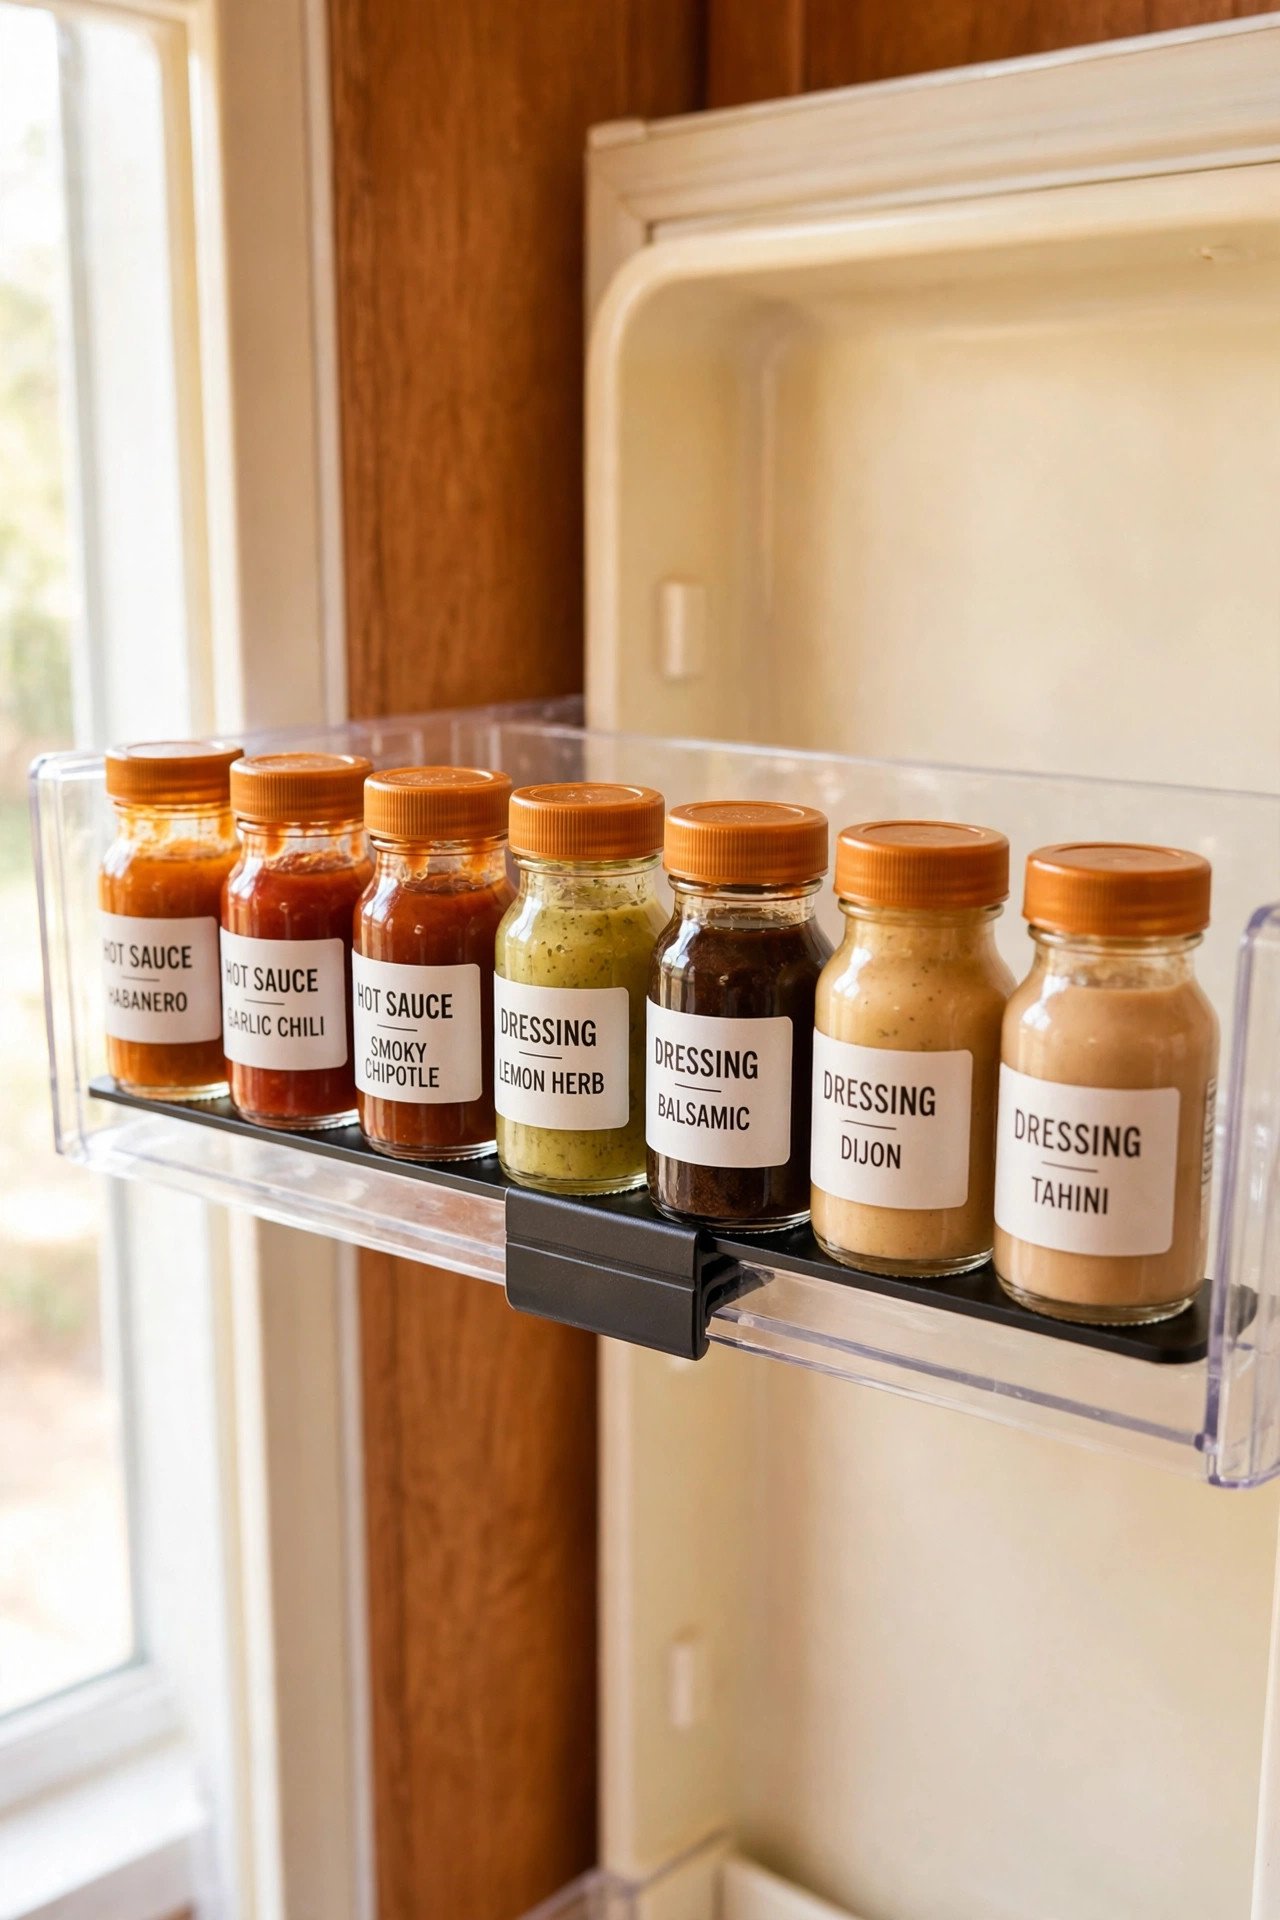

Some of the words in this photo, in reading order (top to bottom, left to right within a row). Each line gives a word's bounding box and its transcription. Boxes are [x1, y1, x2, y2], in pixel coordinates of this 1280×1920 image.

[130, 945, 192, 969] SAUCE
[225, 959, 248, 988] HOT
[254, 967, 318, 993] SAUCE
[357, 982, 381, 1013] HOT
[386, 991, 453, 1019] SAUCE
[278, 1016, 325, 1037] CHILI
[501, 1007, 596, 1046] DRESSING
[371, 1036, 426, 1063] SMOKY
[655, 1037, 758, 1079] DRESSING
[365, 1058, 439, 1088] CHIPOTLE
[499, 1058, 545, 1092] LEMON
[552, 1071, 604, 1094] HERB
[658, 1093, 750, 1130] BALSAMIC
[824, 1070, 936, 1117] DRESSING
[1015, 1108, 1141, 1158] DRESSING
[841, 1135, 901, 1169] DIJON
[1031, 1176, 1109, 1215] TAHINI
